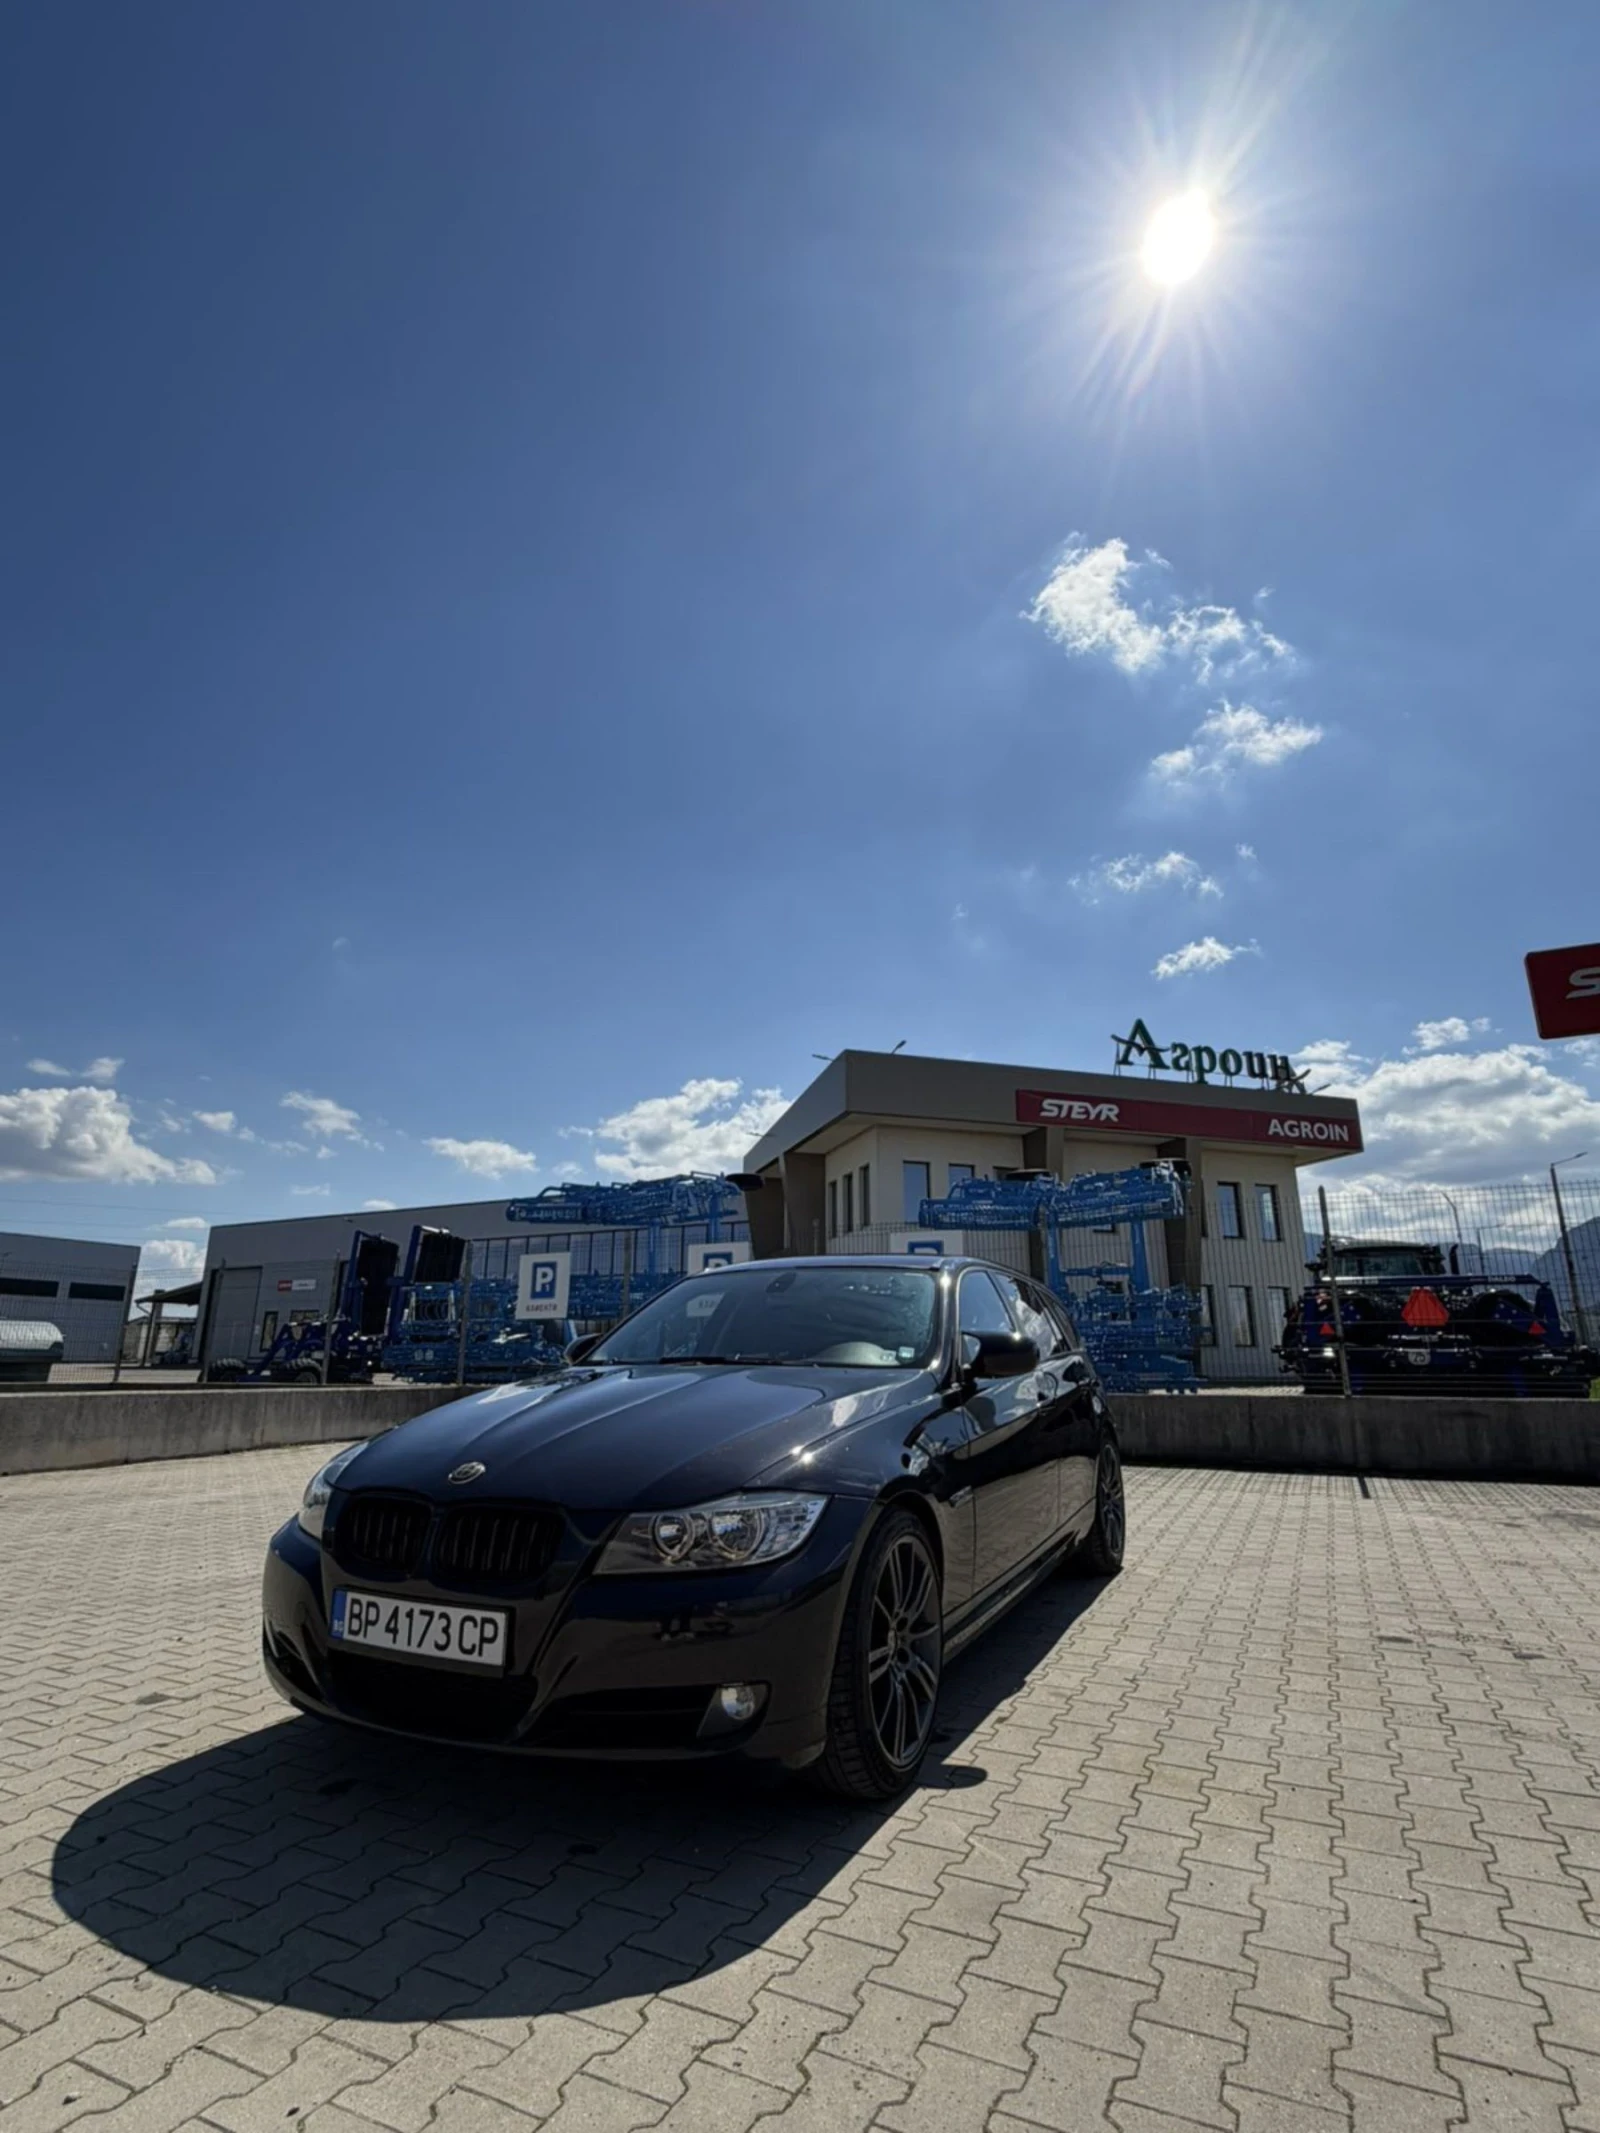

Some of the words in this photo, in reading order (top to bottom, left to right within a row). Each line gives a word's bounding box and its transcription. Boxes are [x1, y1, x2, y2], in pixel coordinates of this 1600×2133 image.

[1111, 1017, 1291, 1085] Агроин
[1040, 1098, 1119, 1122] STEYR
[1268, 1118, 1349, 1142] AGROIN
